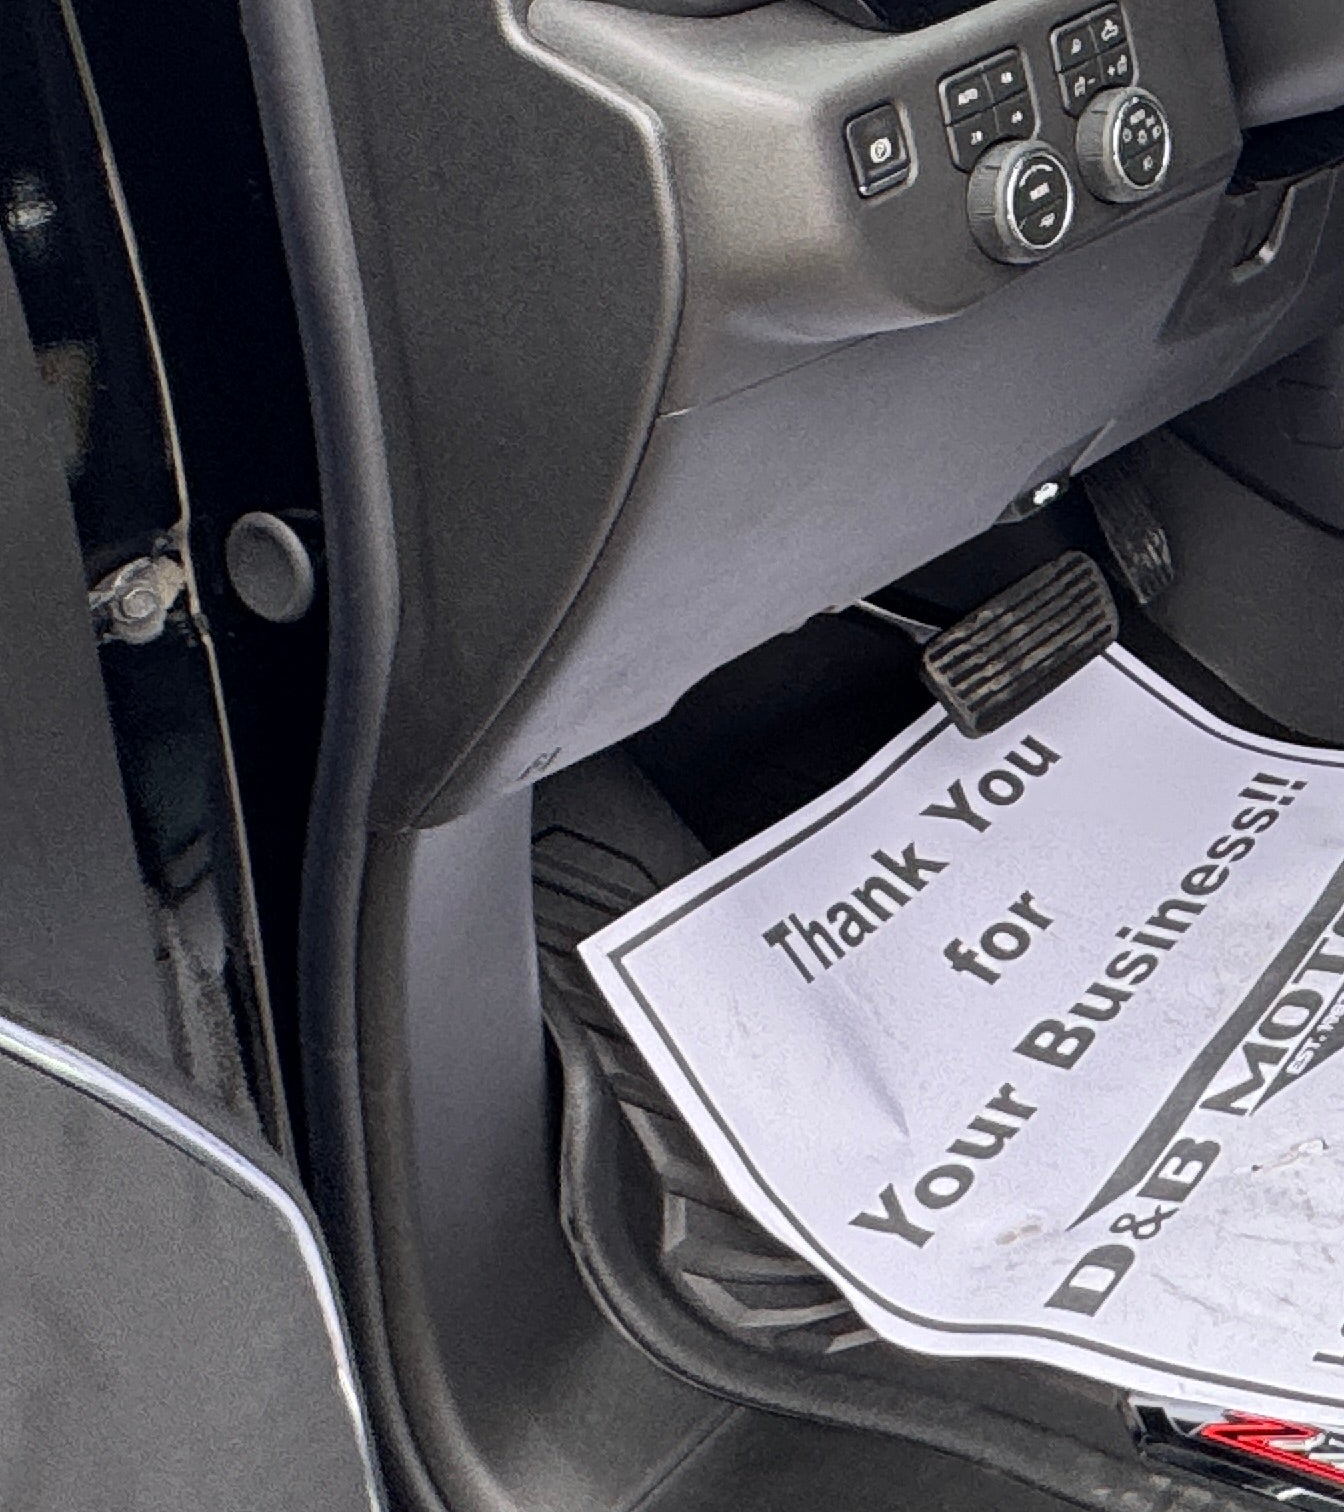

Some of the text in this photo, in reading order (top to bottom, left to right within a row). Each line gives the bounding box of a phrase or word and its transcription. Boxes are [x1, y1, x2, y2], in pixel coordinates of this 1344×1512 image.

[762, 734, 1062, 983] Thank You
[942, 890, 1055, 985] for
[849, 772, 1308, 1249] Your Business!!
[1044, 1136, 1222, 1317] D&B
